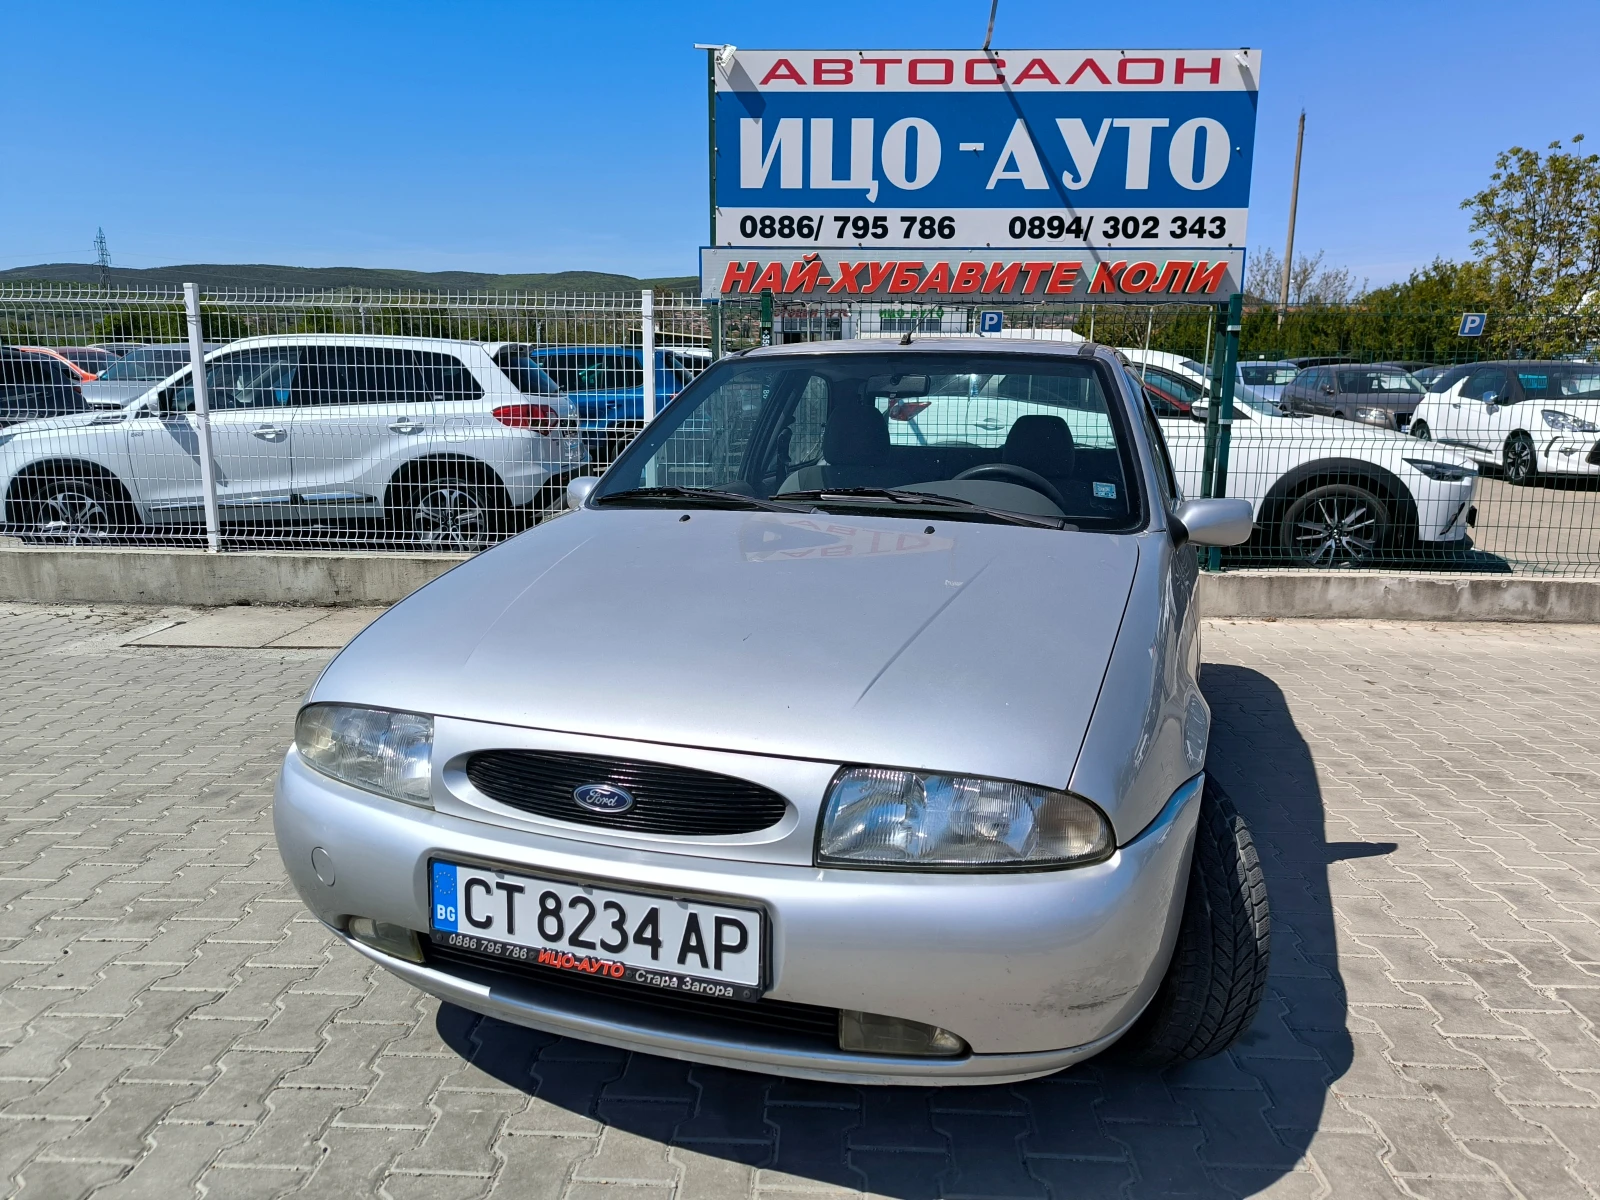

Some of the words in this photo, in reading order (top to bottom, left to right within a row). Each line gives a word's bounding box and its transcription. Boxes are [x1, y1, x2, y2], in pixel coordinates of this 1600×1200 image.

[758, 57, 1221, 85] АВТОСАЛОН
[739, 214, 825, 241] 0886/
[833, 215, 889, 239] 795
[900, 215, 956, 240] 786
[1008, 215, 1095, 241] 0894/
[1102, 215, 1160, 240] 302
[1169, 215, 1227, 240] 343
[719, 252, 1083, 294] НАЙ-ХУБАВИТЕ
[1086, 260, 1229, 294] КОЛИ
[984, 313, 999, 331] P
[1463, 315, 1481, 334] P
[585, 788, 619, 807] Ford
[436, 904, 456, 922] BG
[464, 877, 526, 936] CT
[537, 890, 663, 961] 8234
[677, 911, 749, 971] AP
[448, 933, 478, 949] 0886
[480, 940, 503, 954] 795
[505, 945, 528, 960] 786
[537, 948, 625, 979] ИЦО-АУТО
[635, 969, 678, 988] Стара
[682, 976, 734, 997] Загора
